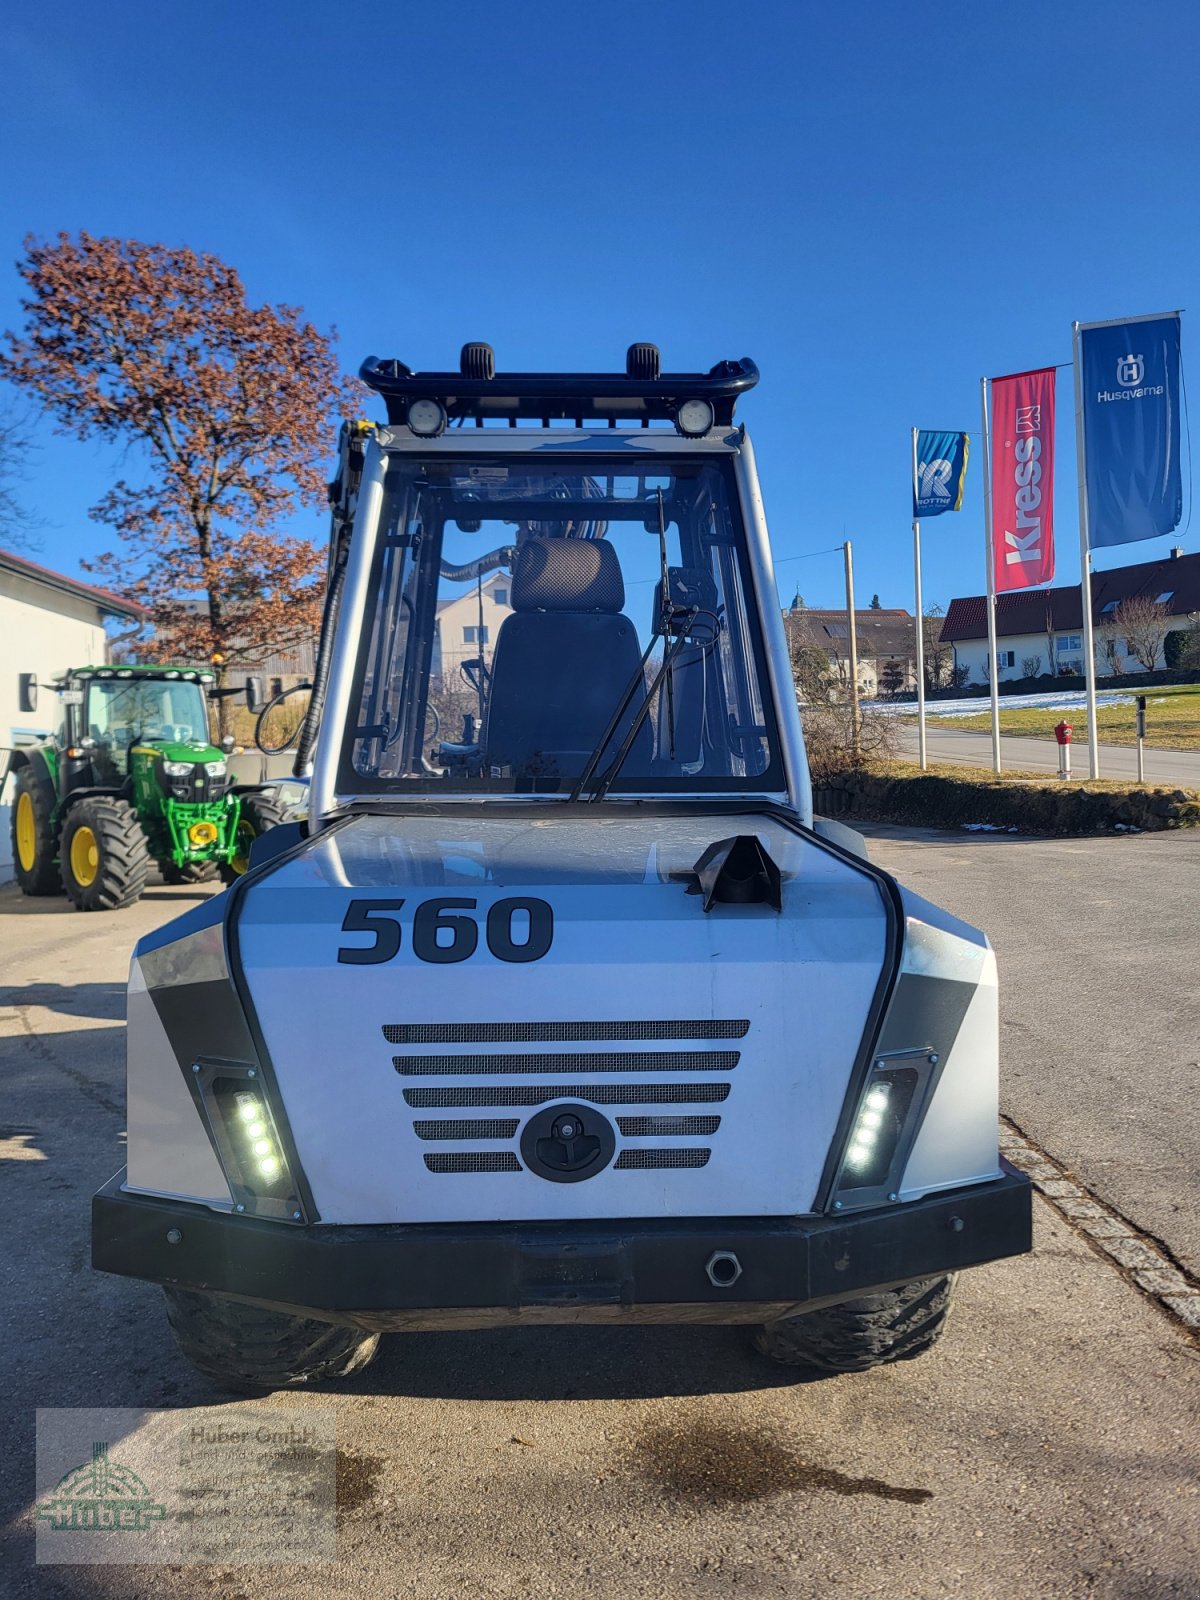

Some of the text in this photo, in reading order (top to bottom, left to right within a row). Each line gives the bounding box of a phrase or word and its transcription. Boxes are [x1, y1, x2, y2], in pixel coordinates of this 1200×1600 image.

[1097, 385, 1164, 403] Husqvarna
[1005, 435, 1042, 566] Kress
[337, 897, 554, 965] 560
